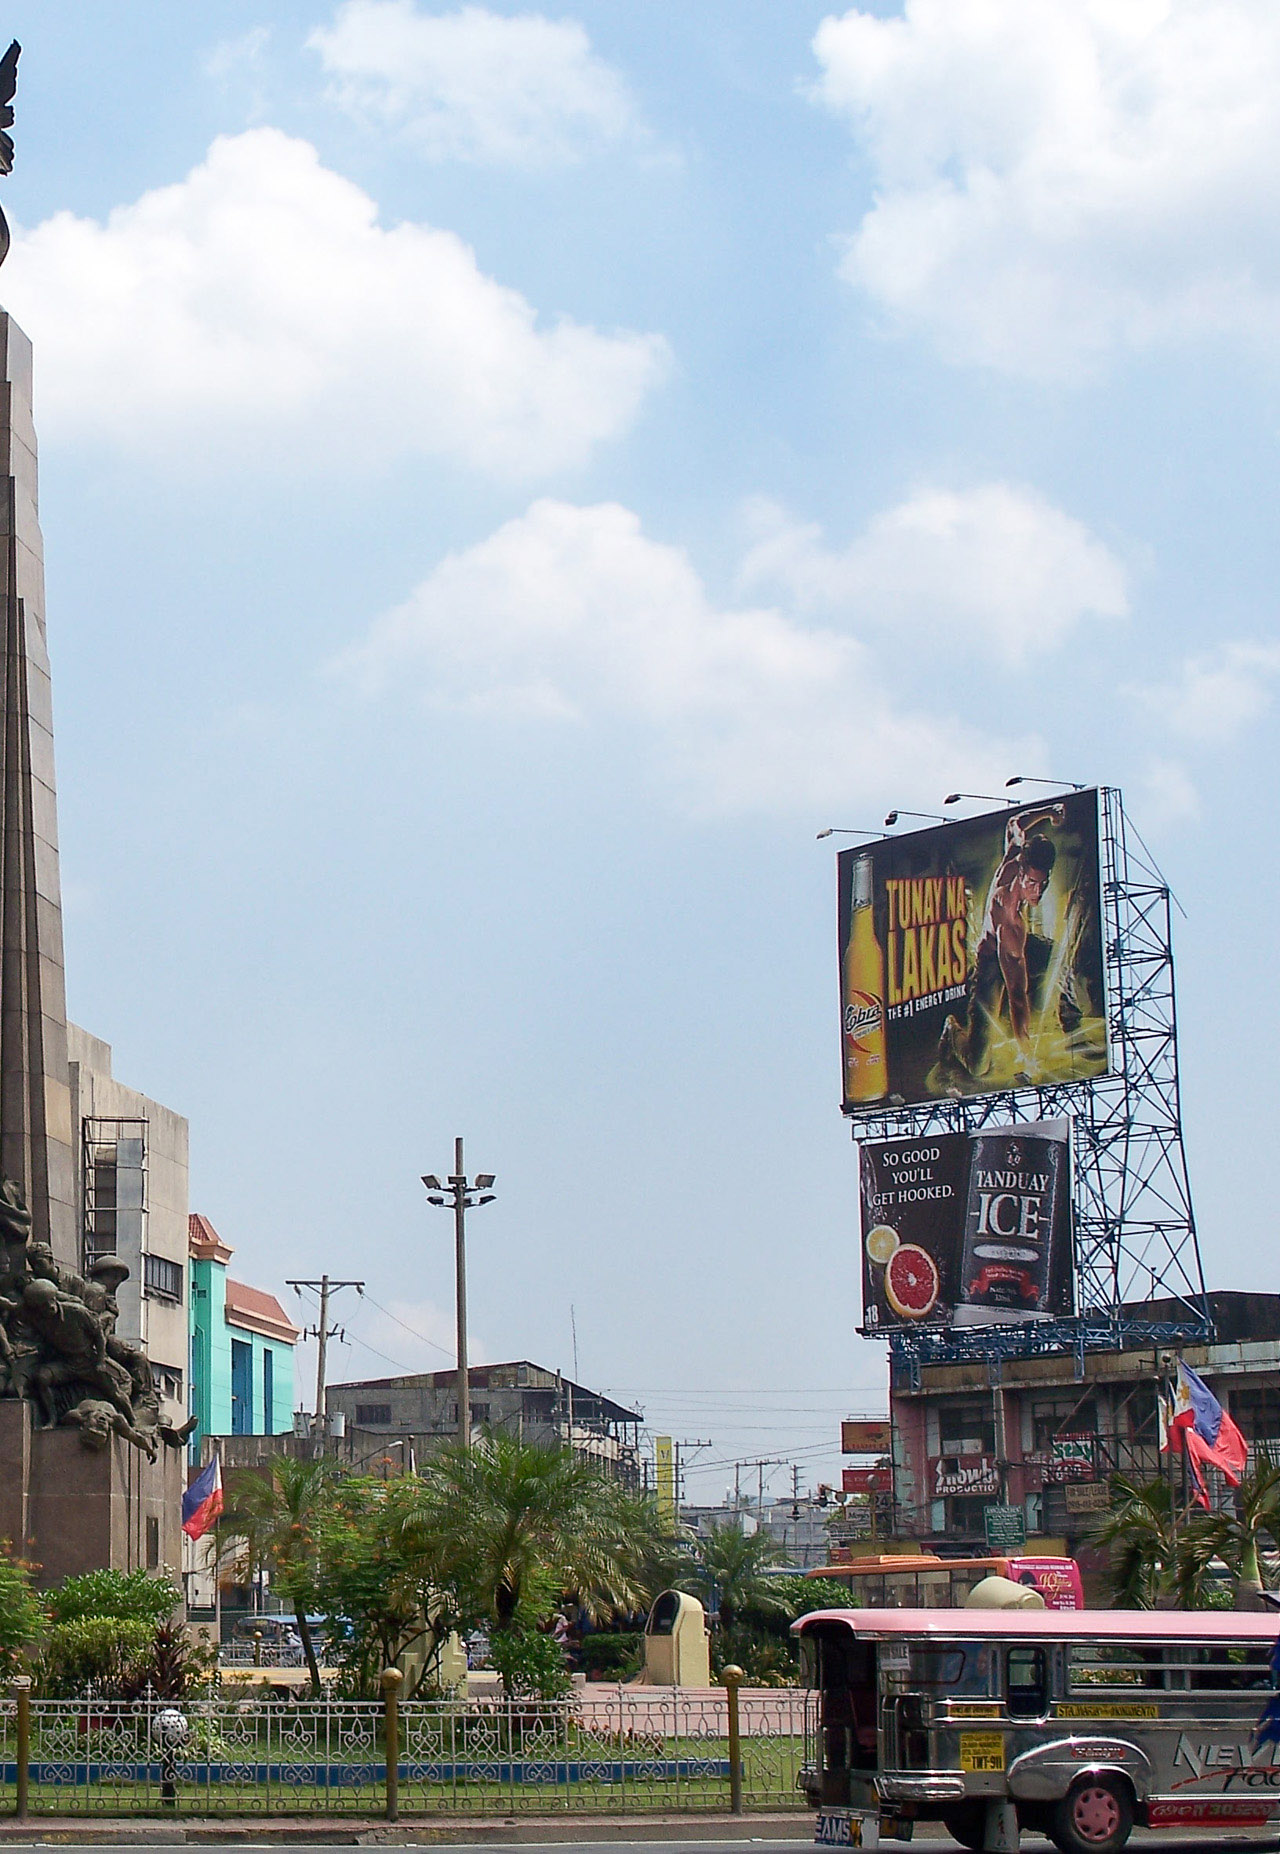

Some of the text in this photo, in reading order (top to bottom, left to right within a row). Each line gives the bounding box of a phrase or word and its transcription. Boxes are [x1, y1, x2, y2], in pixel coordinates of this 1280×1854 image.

[885, 876, 967, 930] TUNAY NA
[887, 918, 967, 1006] LAKAS
[888, 984, 966, 1020] THE #1 ENERGY DRINK
[845, 1003, 882, 1032] Cobra
[883, 1148, 940, 1167] SO GOOD
[892, 1168, 933, 1184] YOU'LL
[976, 1170, 1049, 1192] TANDUAY
[873, 1185, 955, 1206] GET HOOKED.
[976, 1193, 1041, 1239] ICE
